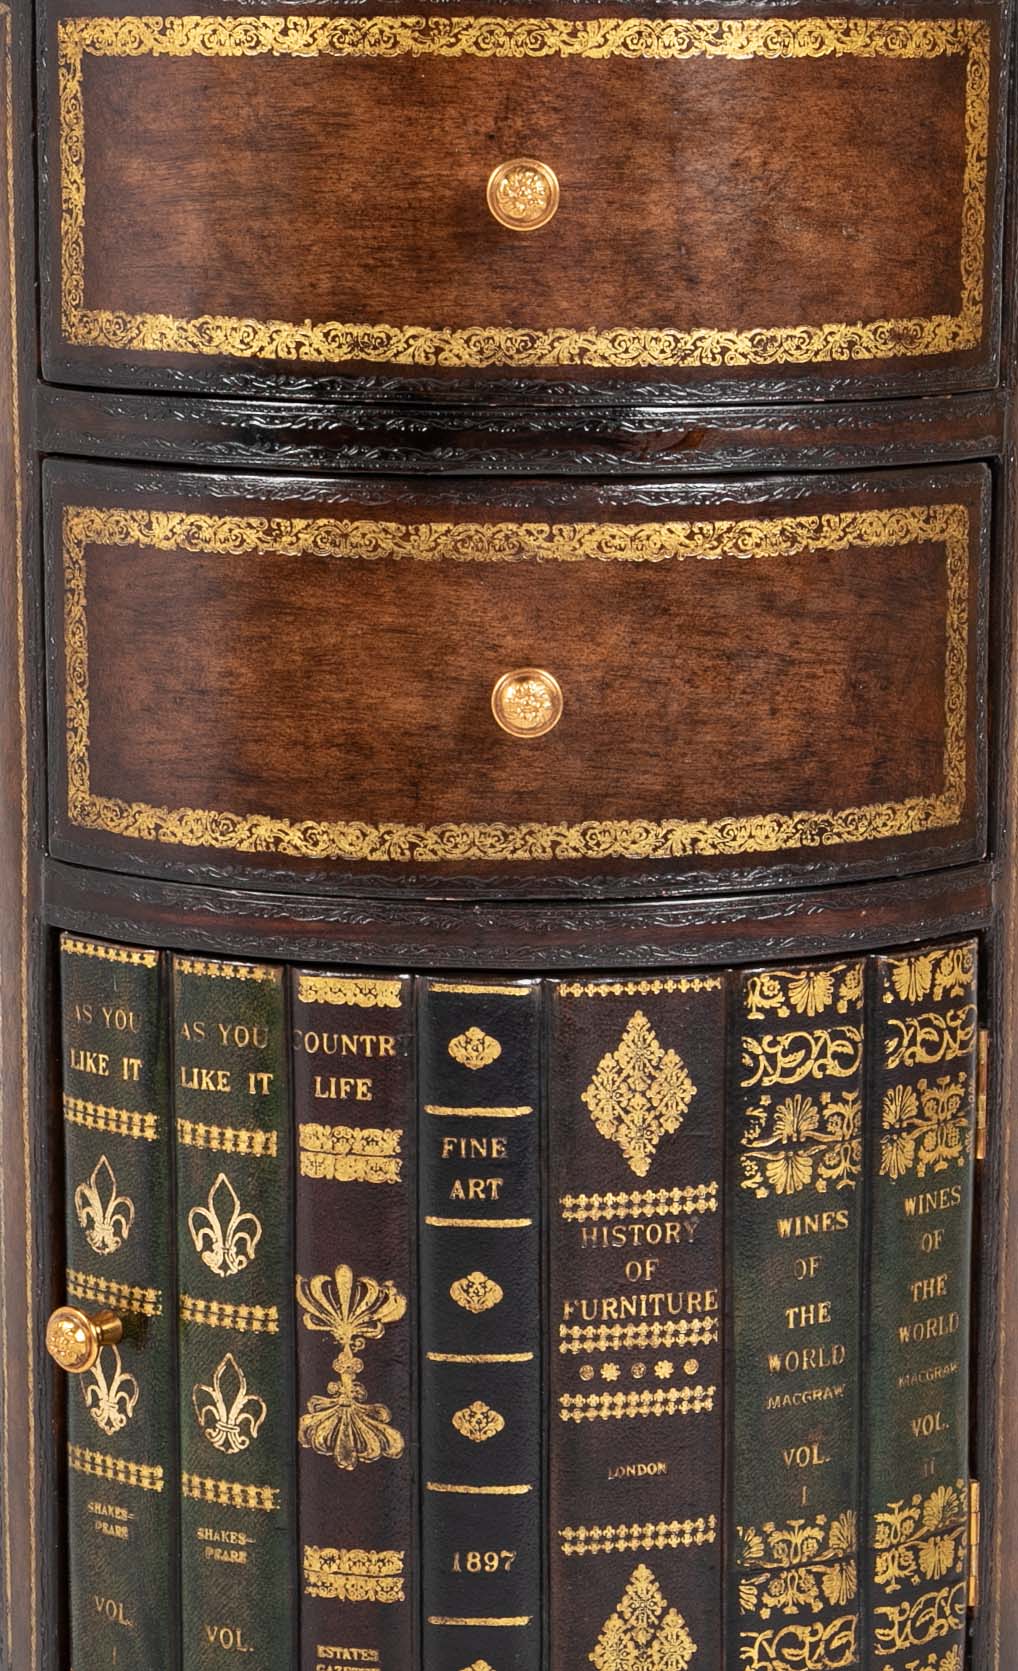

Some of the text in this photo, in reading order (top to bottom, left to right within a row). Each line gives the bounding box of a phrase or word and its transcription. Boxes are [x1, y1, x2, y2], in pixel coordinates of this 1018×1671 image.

[74, 1004, 141, 1033] AS YOU
[181, 1022, 269, 1049] AS YOU
[70, 1048, 144, 1081] LIKE IT
[180, 1066, 274, 1096] LIKE IT
[313, 1075, 373, 1101] LIFE
[440, 1137, 508, 1159] FINE
[449, 1178, 504, 1201] ART
[903, 1185, 962, 1217] WINES
[580, 1220, 699, 1249] HISTORY
[776, 1209, 849, 1239] WINES
[920, 1228, 945, 1254] OF
[625, 1258, 660, 1282] OF
[793, 1255, 822, 1281] OF
[911, 1273, 949, 1303] THE
[562, 1287, 720, 1321] FURNITURE
[784, 1300, 832, 1329] THE
[898, 1311, 960, 1344] WORLD
[766, 1343, 846, 1374] WORLD
[766, 1383, 846, 1410] MACGRAW
[607, 1461, 668, 1480] LONDON
[451, 1551, 517, 1573] 1897
[316, 1644, 380, 1662] ESTATES
